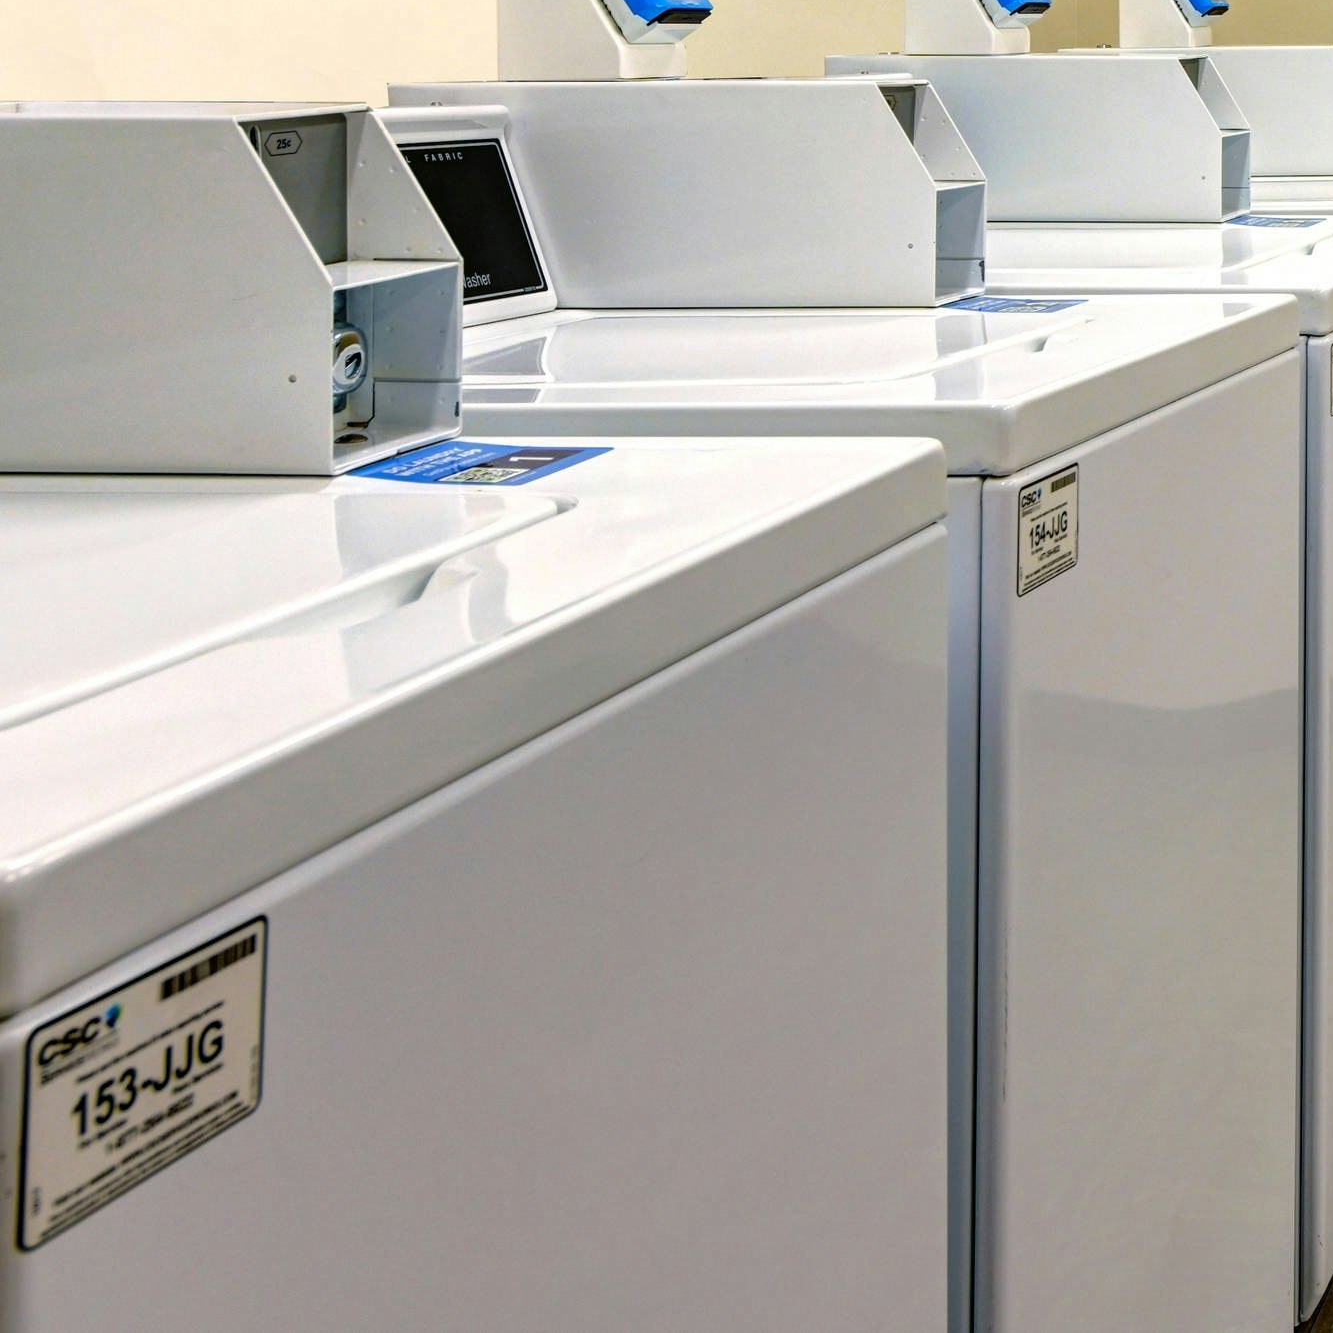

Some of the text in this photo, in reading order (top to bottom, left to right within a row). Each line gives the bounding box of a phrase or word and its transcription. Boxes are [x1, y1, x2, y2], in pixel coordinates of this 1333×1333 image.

[424, 152, 463, 162] FABRIC
[1021, 491, 1037, 507] CSC
[1029, 511, 1068, 548] 154-JJG
[38, 1016, 103, 1067] CSC
[72, 1019, 225, 1136] 153-JJG
